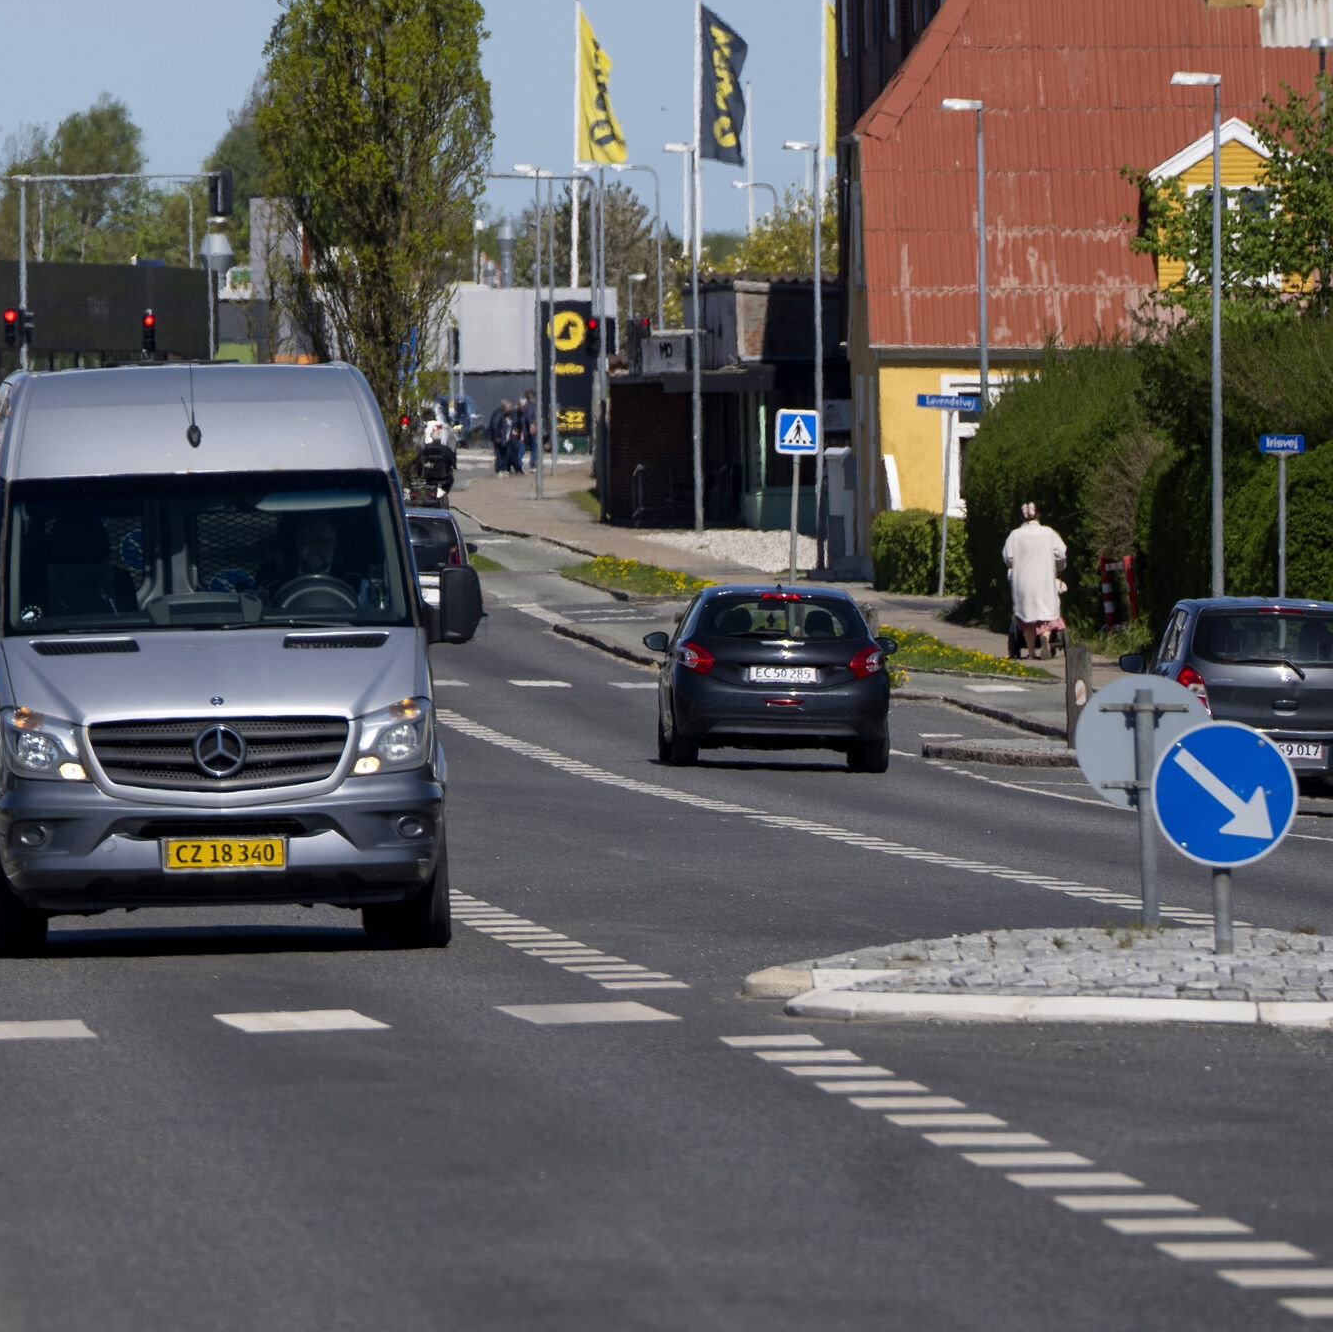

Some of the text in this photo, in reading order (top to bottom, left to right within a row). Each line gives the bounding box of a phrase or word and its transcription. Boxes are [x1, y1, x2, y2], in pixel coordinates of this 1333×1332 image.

[1266, 437, 1299, 450] Irisvej
[756, 668, 771, 678] EC
[774, 668, 787, 678] 50
[1297, 744, 1320, 756] 017
[175, 843, 275, 863] CZ 18 340
